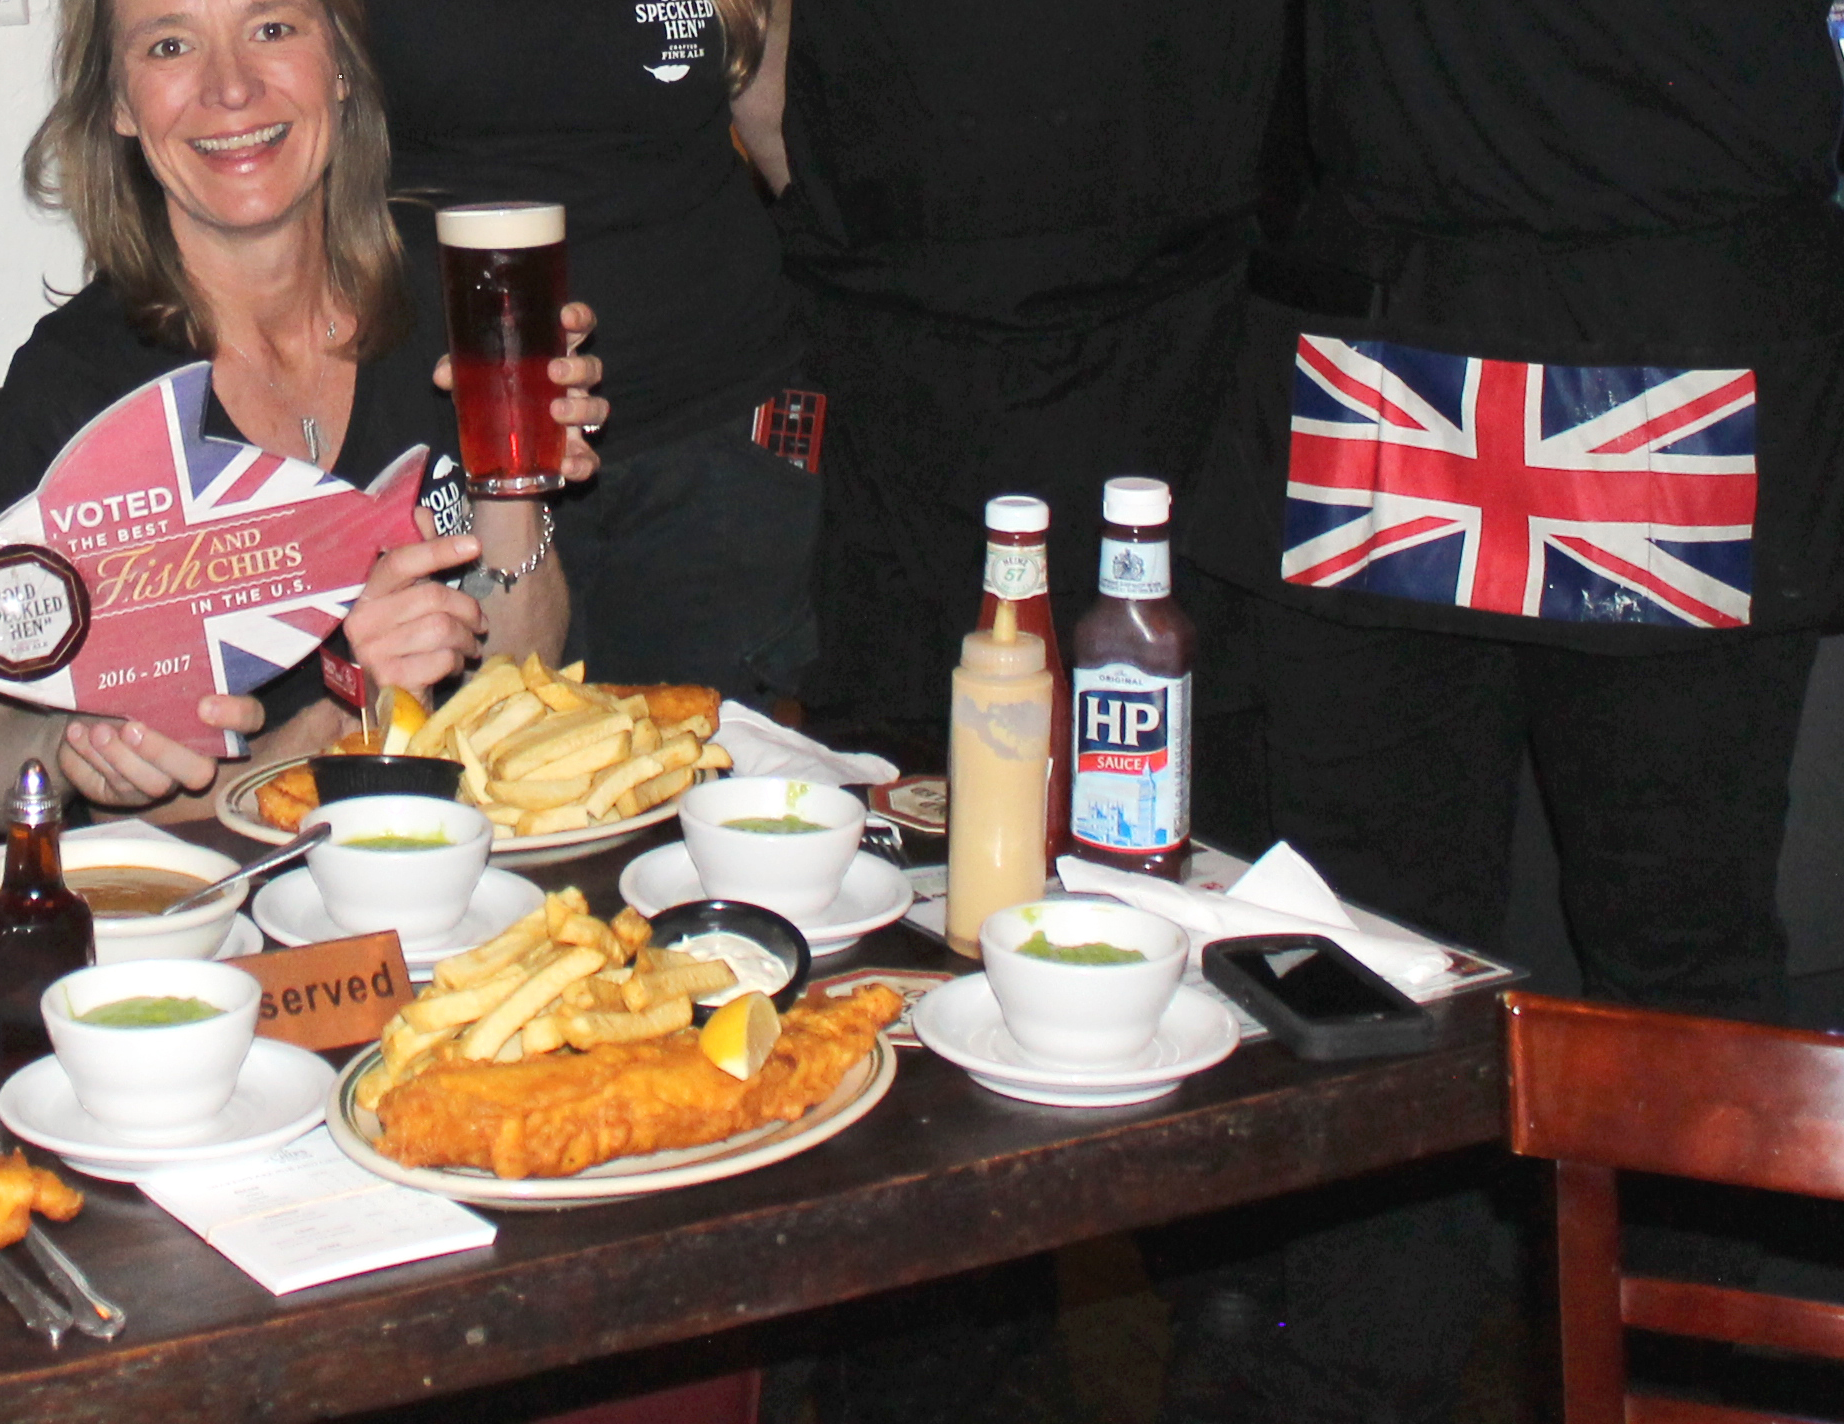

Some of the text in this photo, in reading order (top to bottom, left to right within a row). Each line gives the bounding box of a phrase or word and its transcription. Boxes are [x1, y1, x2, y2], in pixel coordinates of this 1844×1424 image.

[635, 0, 713, 23] SPECKLED
[662, 48, 705, 60] FINE ALE
[49, 486, 175, 533] VOTED
[67, 519, 169, 553] THE BEST
[93, 528, 261, 613] Fish AND
[207, 543, 304, 585] CHIPS
[191, 582, 312, 616] IN THE U.S.
[97, 655, 192, 691] 2016 2017
[1099, 675, 1143, 686] ORIGINAL
[1086, 695, 1160, 747] HP
[1097, 756, 1142, 770] SAUCE
[260, 961, 395, 1020] served
